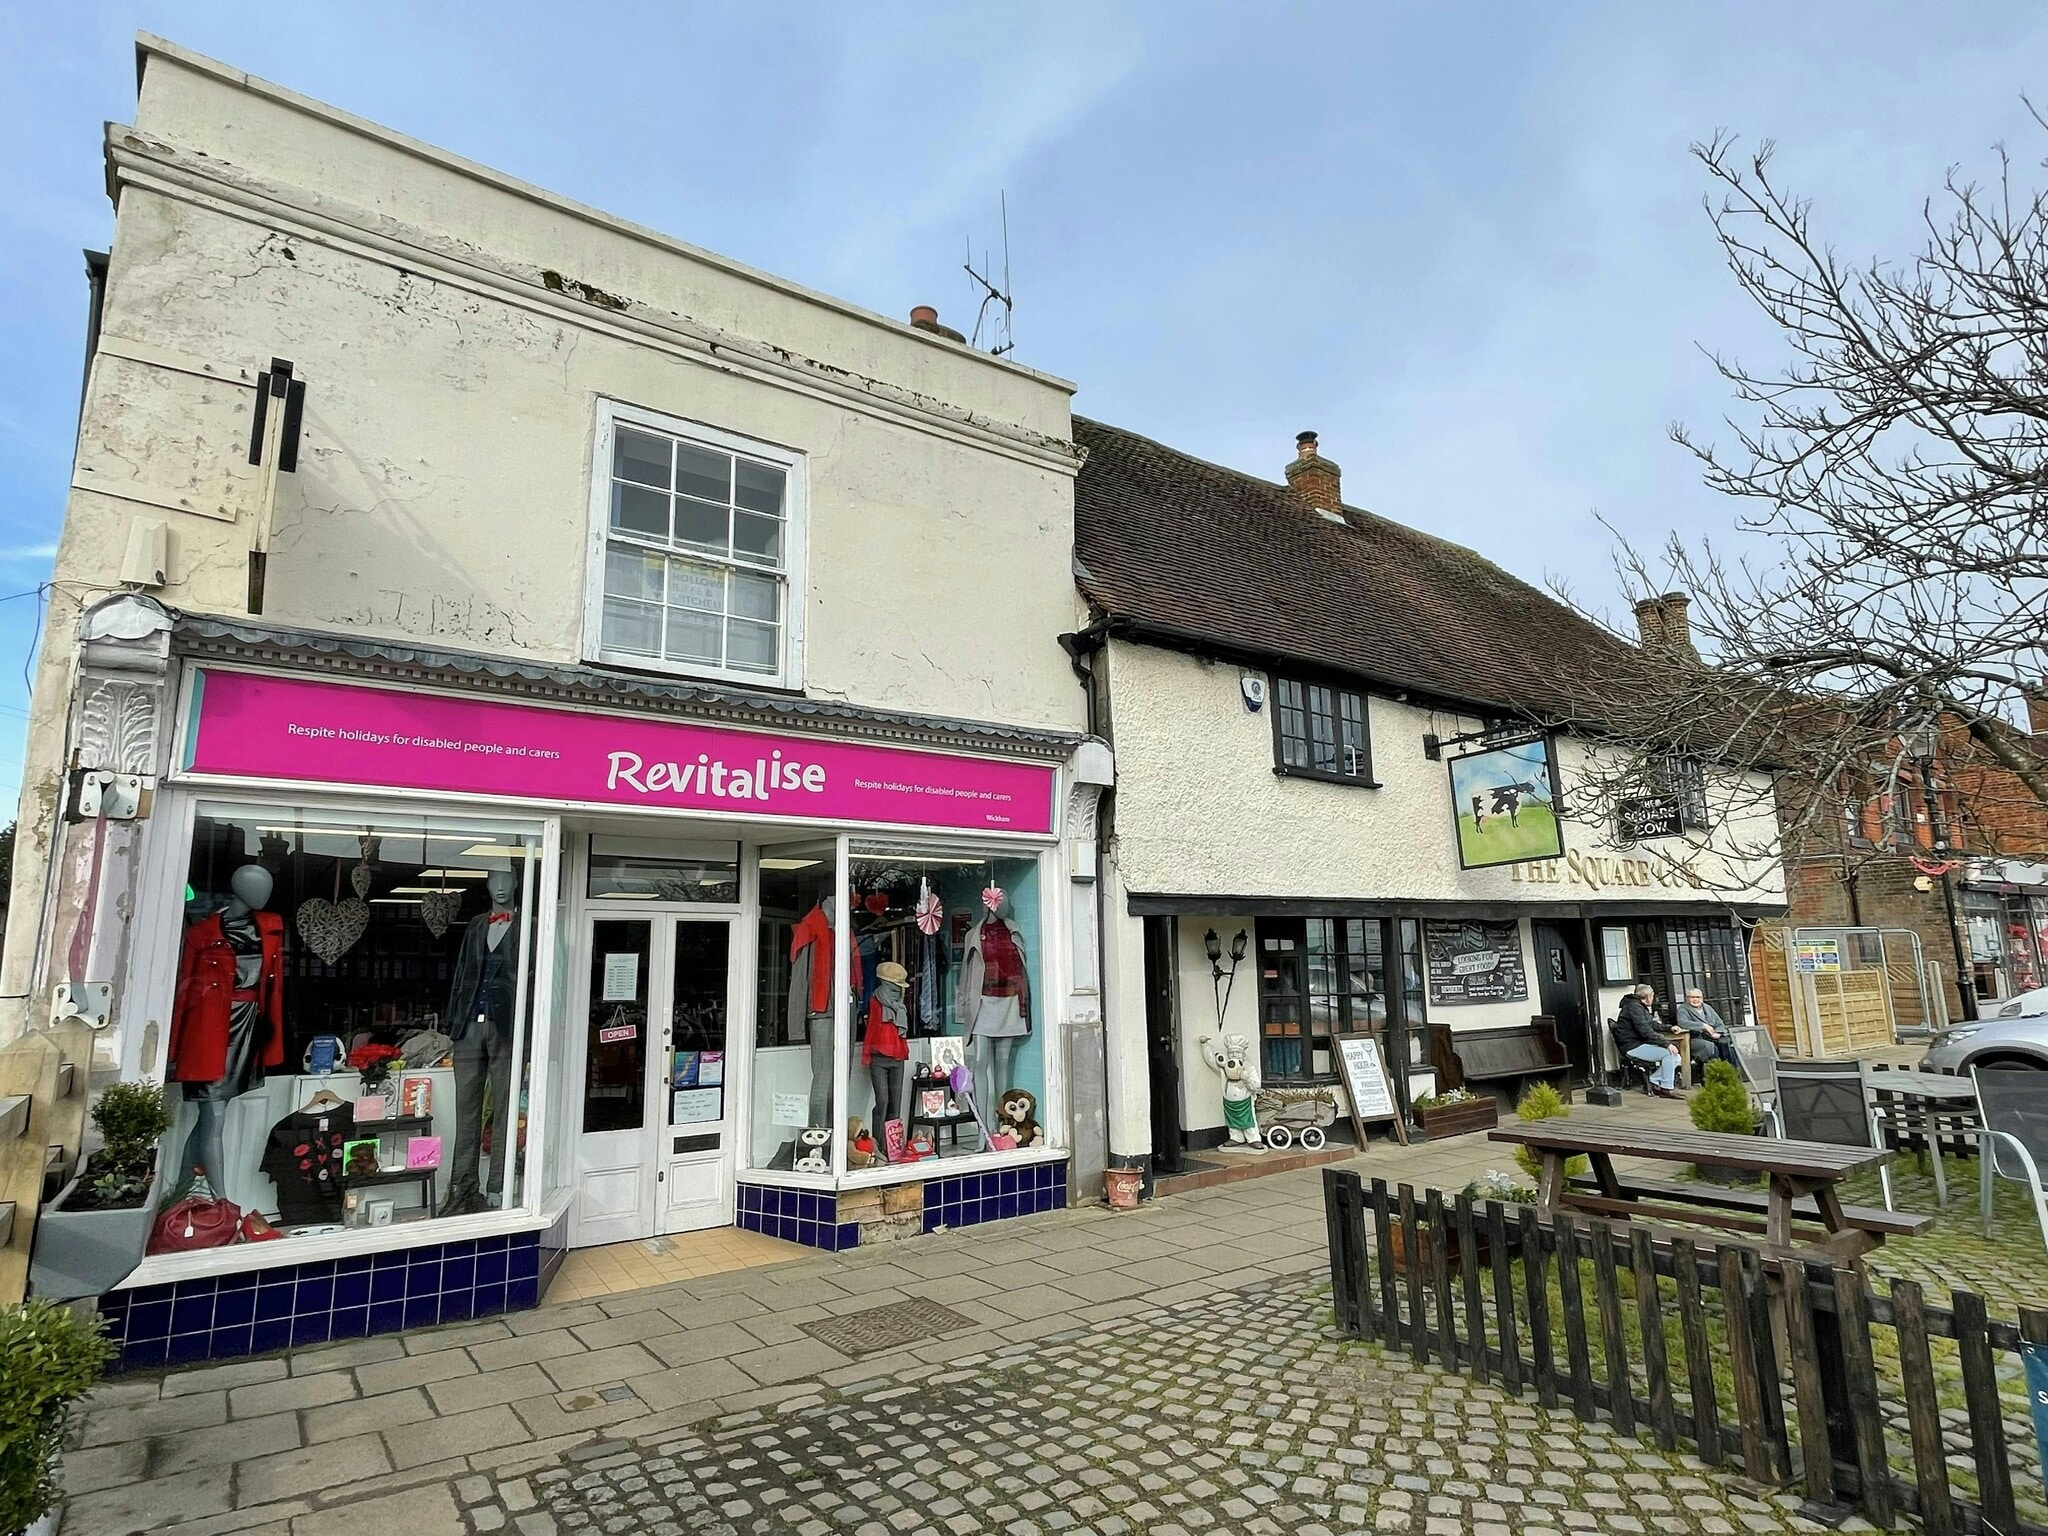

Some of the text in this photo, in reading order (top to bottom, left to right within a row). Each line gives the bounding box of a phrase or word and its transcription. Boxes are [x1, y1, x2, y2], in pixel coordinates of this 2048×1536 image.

[287, 723, 560, 760] Respite holidays for disabled people and carers
[606, 750, 826, 800] Revitalise
[854, 778, 1012, 802] Respite holidays for disabled people and carers
[985, 814, 1011, 822] Wickham
[1633, 821, 1668, 836] COW
[607, 1029, 629, 1039] OPEN
[1345, 1051, 1364, 1061] HAPPY
[1352, 1060, 1370, 1070] HOUR
